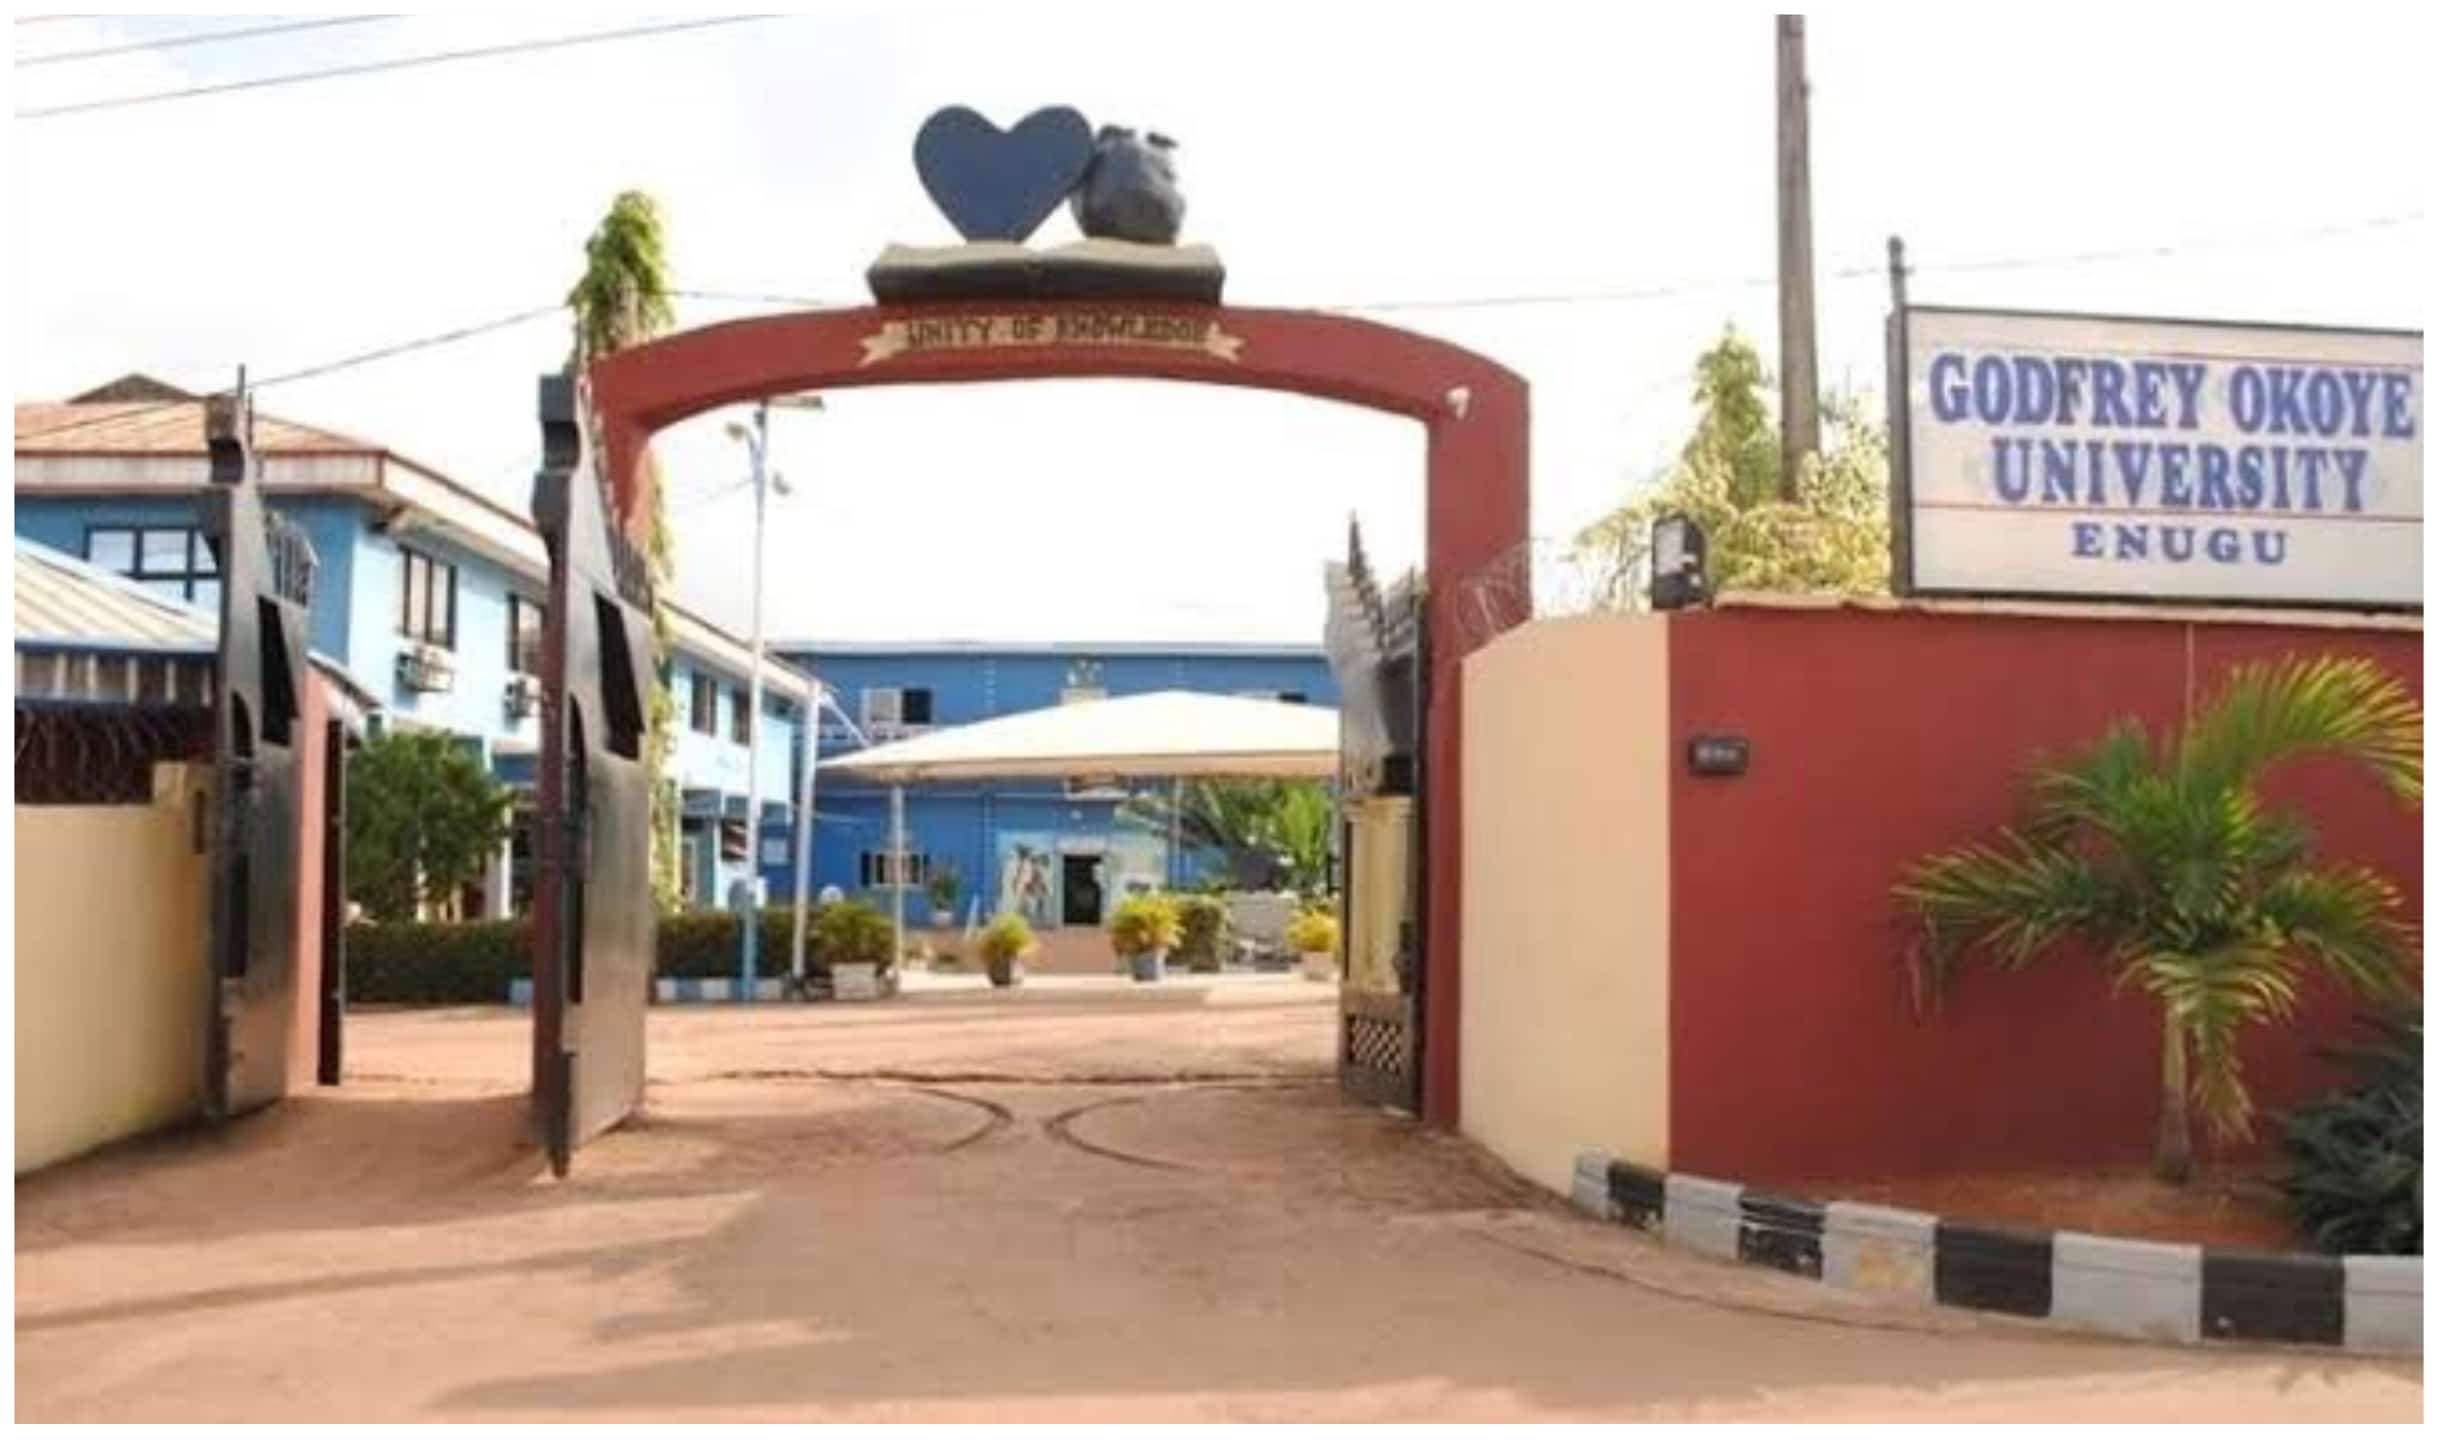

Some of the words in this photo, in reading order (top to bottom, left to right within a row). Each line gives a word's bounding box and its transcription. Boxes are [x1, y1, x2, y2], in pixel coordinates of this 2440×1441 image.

[905, 317, 993, 346] UNITY
[1010, 314, 1044, 341] OF
[1930, 354, 2208, 430] GODFREY
[2229, 366, 2415, 438] OKOYE
[1992, 437, 2368, 511] UNIVERSITY
[2072, 522, 2288, 564] ENUGU
